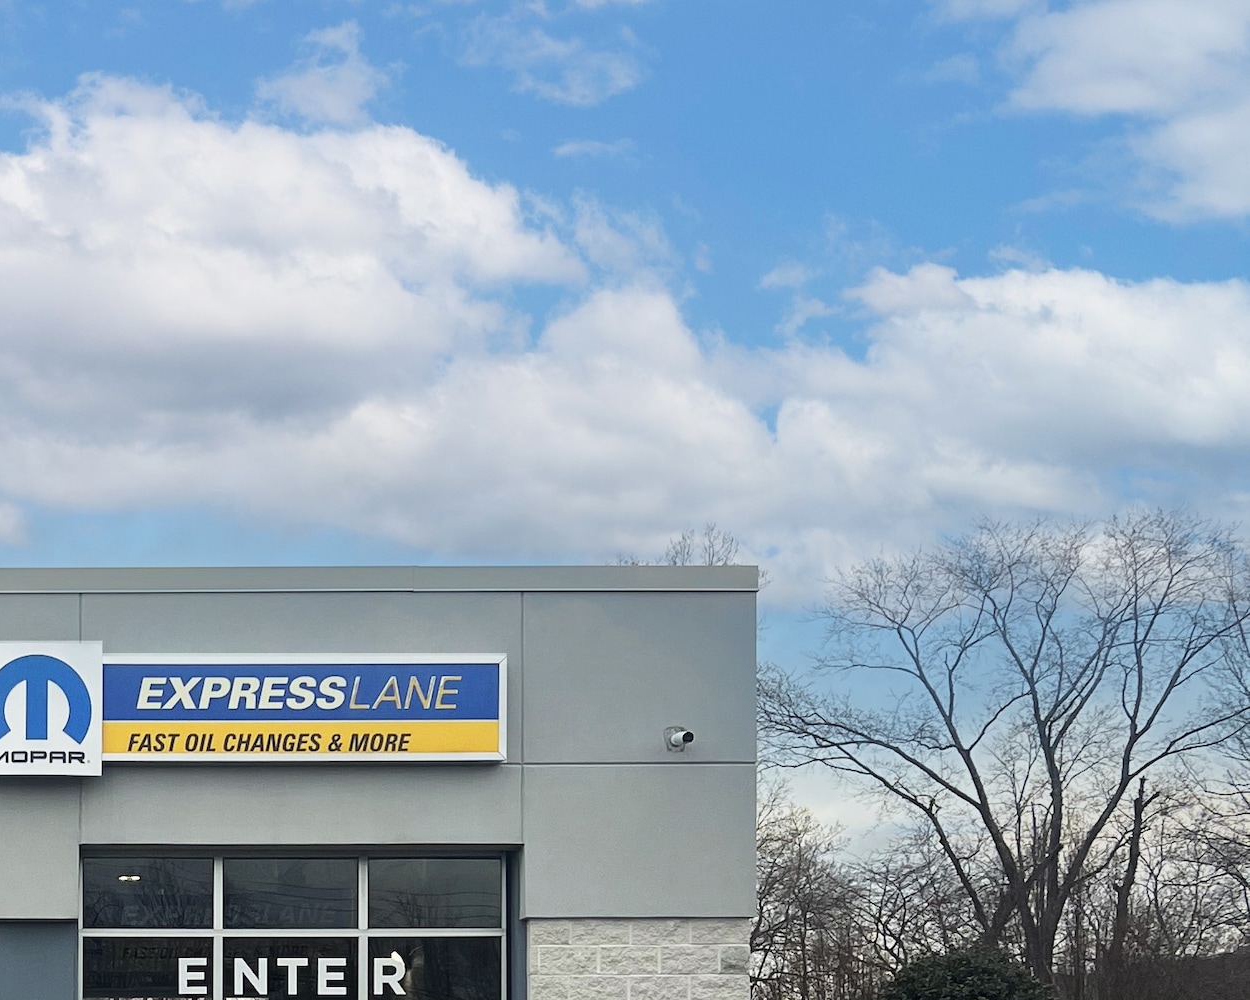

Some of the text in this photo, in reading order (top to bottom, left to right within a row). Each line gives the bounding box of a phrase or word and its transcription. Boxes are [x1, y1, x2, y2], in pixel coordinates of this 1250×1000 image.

[127, 733, 411, 752] FAST OIL CHANGES & MORE
[177, 957, 407, 996] ENTER
